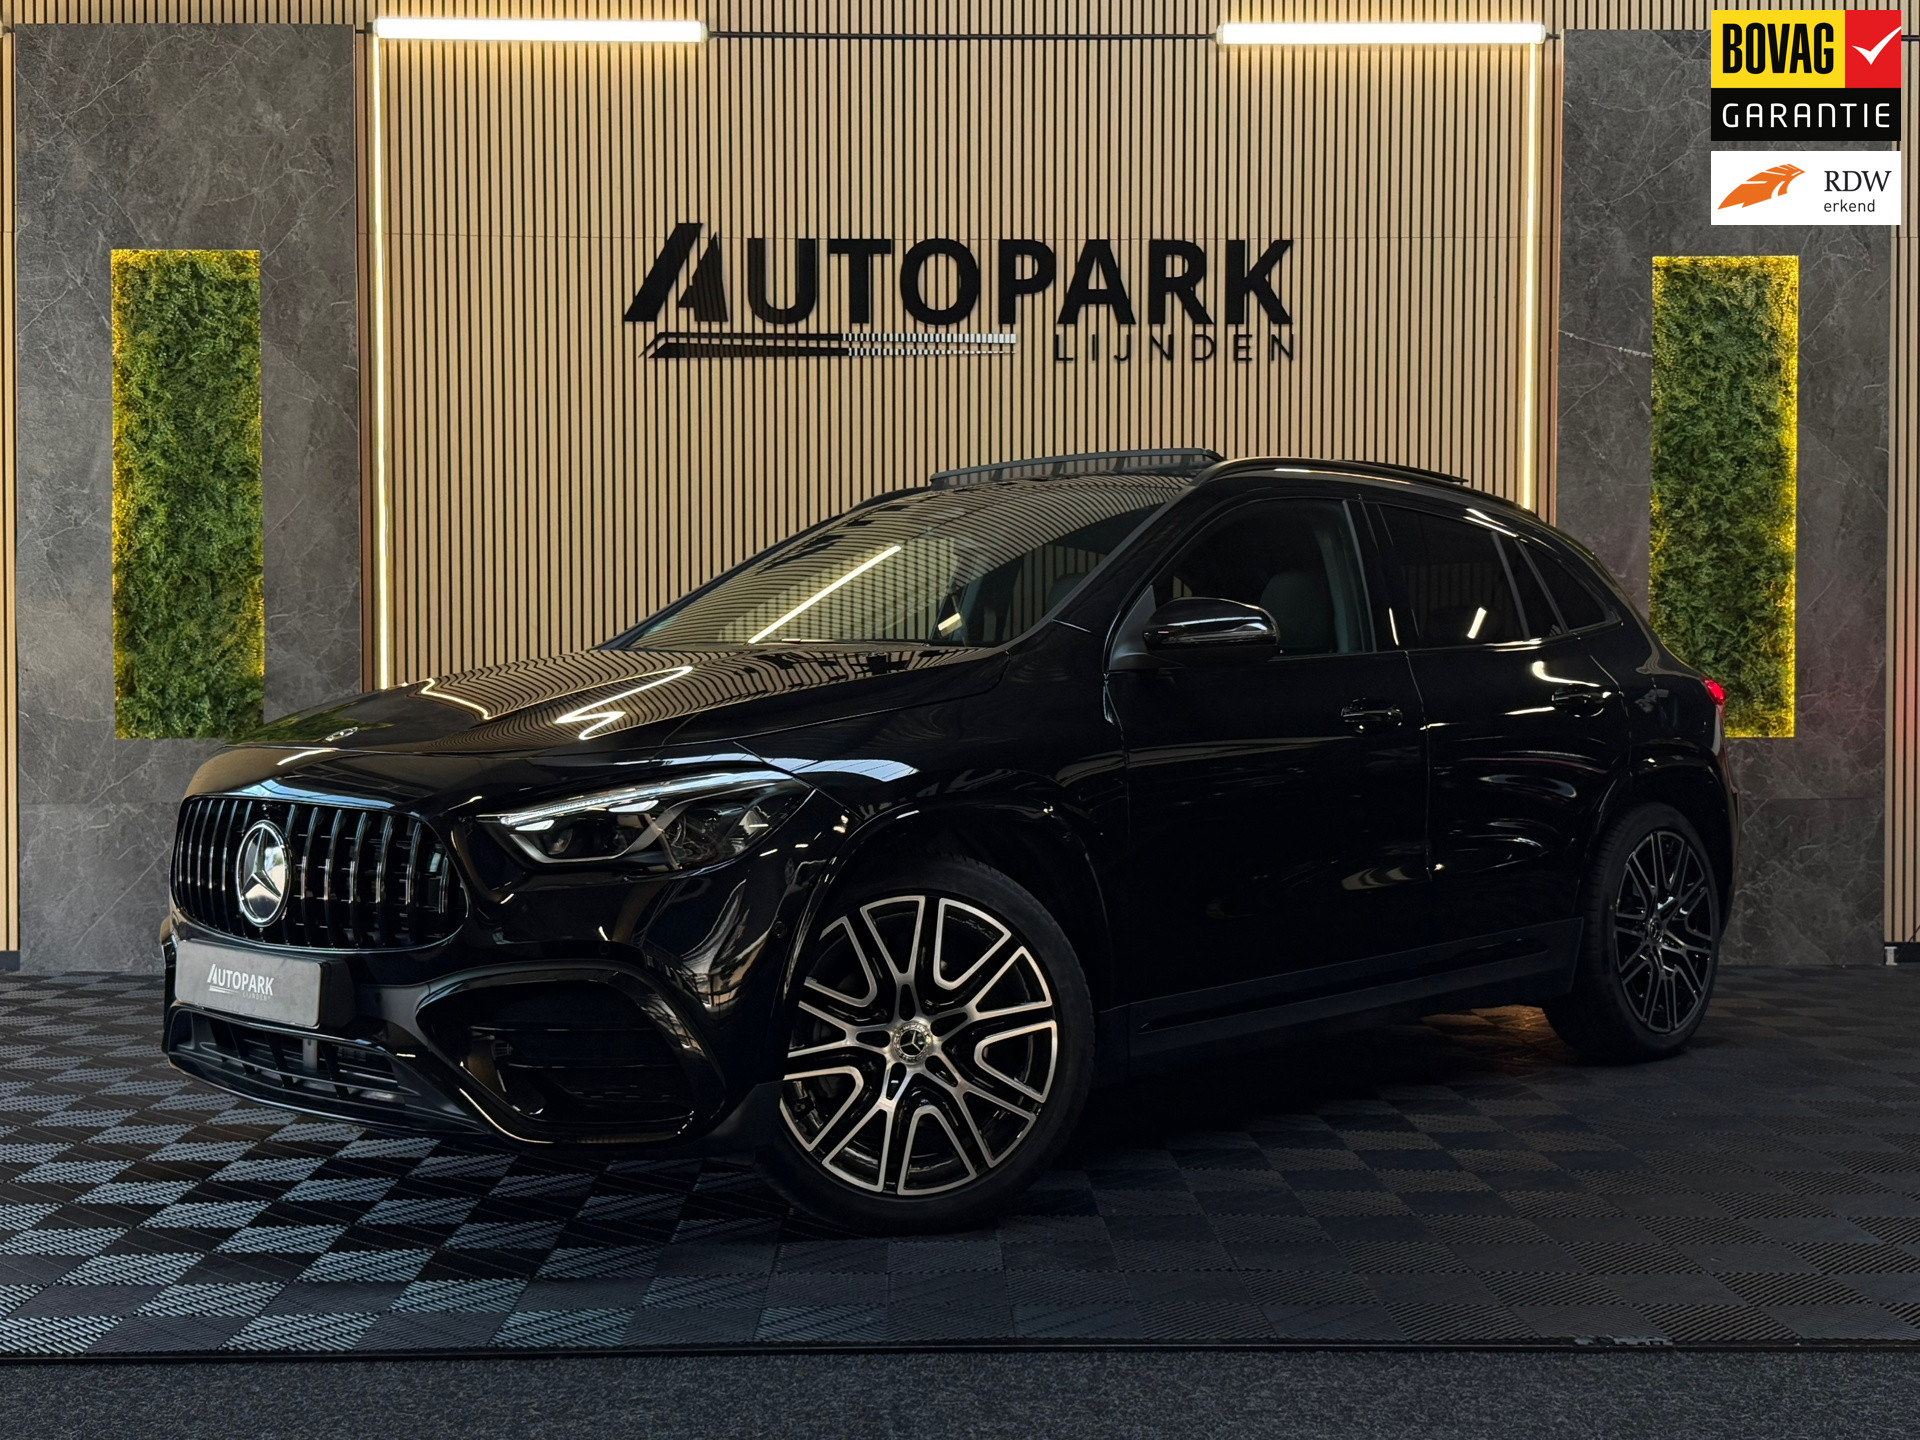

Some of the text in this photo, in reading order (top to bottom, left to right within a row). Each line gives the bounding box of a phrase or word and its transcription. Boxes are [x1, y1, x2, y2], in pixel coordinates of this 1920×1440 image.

[624, 222, 1294, 326] AUTOPARK
[1054, 333, 1295, 363] LIJNDEN
[206, 963, 275, 996] AUTOPARK
